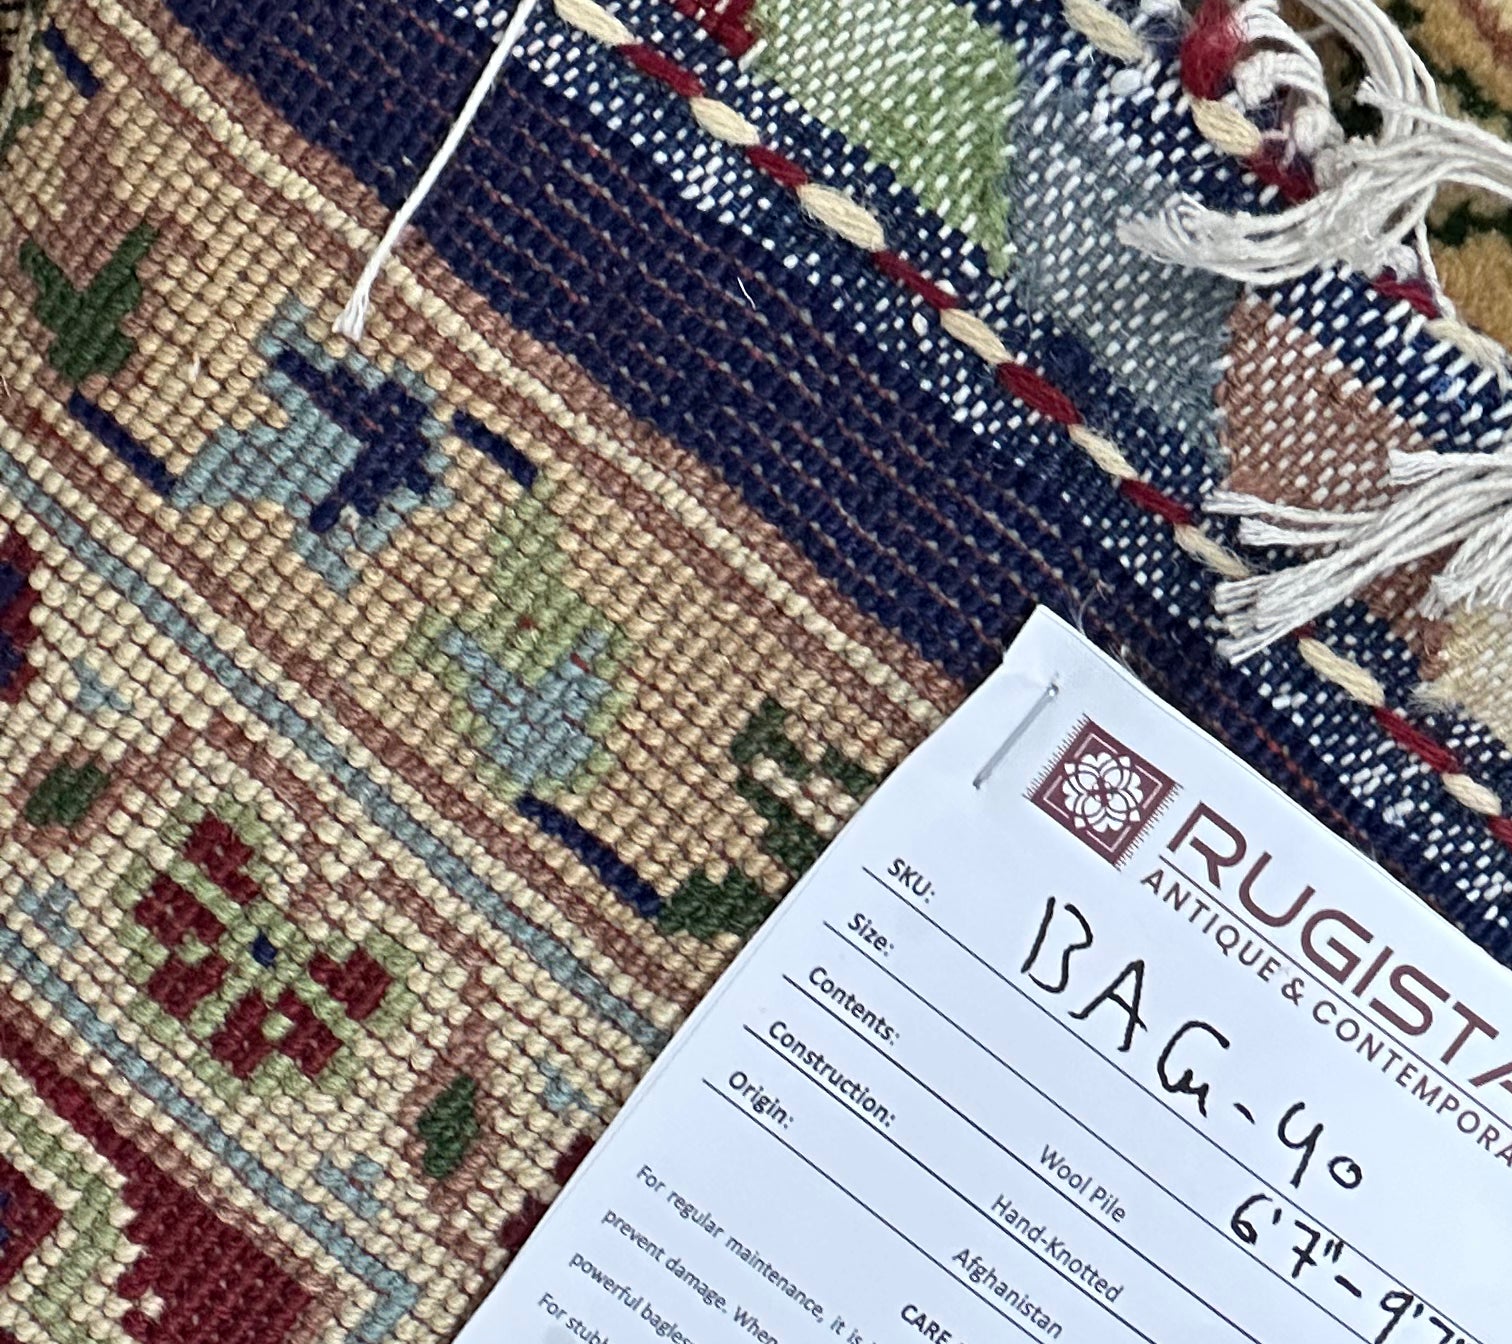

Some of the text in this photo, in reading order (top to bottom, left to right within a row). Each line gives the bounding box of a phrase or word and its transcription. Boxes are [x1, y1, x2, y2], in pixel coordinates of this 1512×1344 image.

[885, 856, 936, 904] SKU:
[846, 911, 895, 957] Size:
[1138, 867, 1282, 983] ANTIQUE
[1279, 976, 1305, 1007] &
[807, 965, 901, 1047] Contents:
[727, 1069, 794, 1130] Origin:
[767, 1019, 896, 1128] Construction:
[1038, 1142, 1126, 1223] Wool Pile
[567, 1251, 644, 1312] powerful
[599, 1208, 666, 1263] prevent
[663, 1256, 727, 1314] damage.
[635, 1163, 667, 1193] For
[665, 1189, 725, 1238] regular
[723, 1235, 824, 1324] maintenance,
[828, 1314, 846, 1336] it
[989, 1192, 1125, 1304] Hand-Knotted
[536, 1290, 568, 1320] For
[950, 1247, 1063, 1340] Afghanistan
